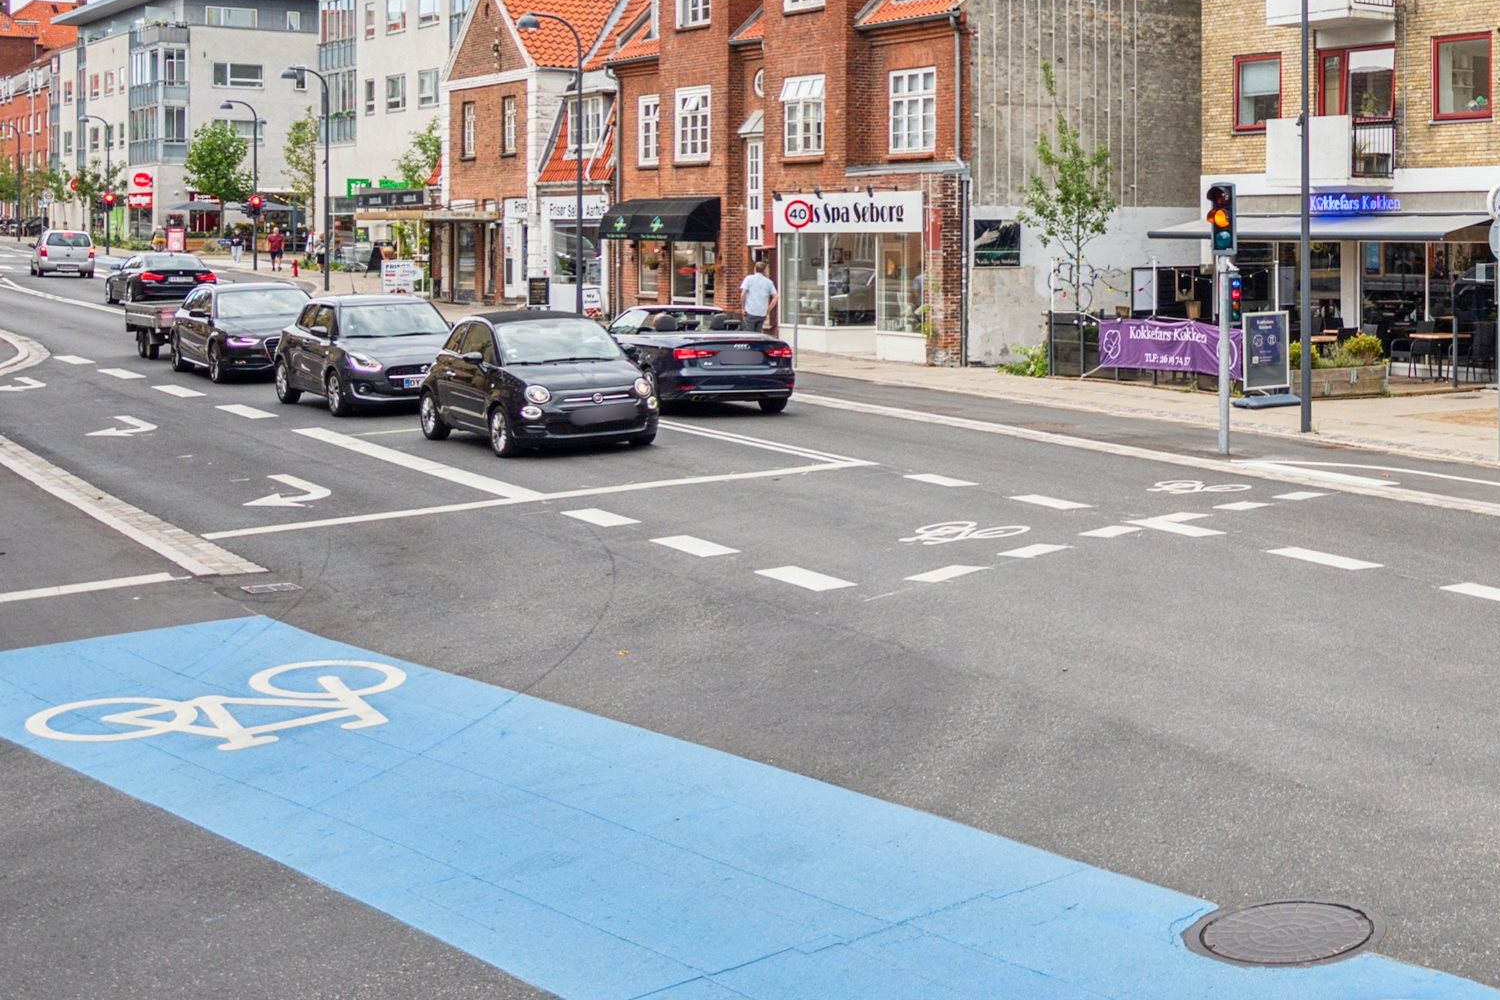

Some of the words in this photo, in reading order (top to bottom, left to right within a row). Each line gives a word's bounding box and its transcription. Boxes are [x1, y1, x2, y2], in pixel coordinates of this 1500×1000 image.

[549, 203, 566, 217] Frisør
[586, 202, 605, 216] Aarhus
[1362, 194, 1401, 210] Køkken
[789, 208, 807, 220] 40
[823, 203, 850, 223] Spa
[1129, 326, 1172, 341] Kokkefars
[1173, 326, 1208, 344] Køkken
[1144, 353, 1159, 362] TLF:
[1159, 355, 1168, 363] 26
